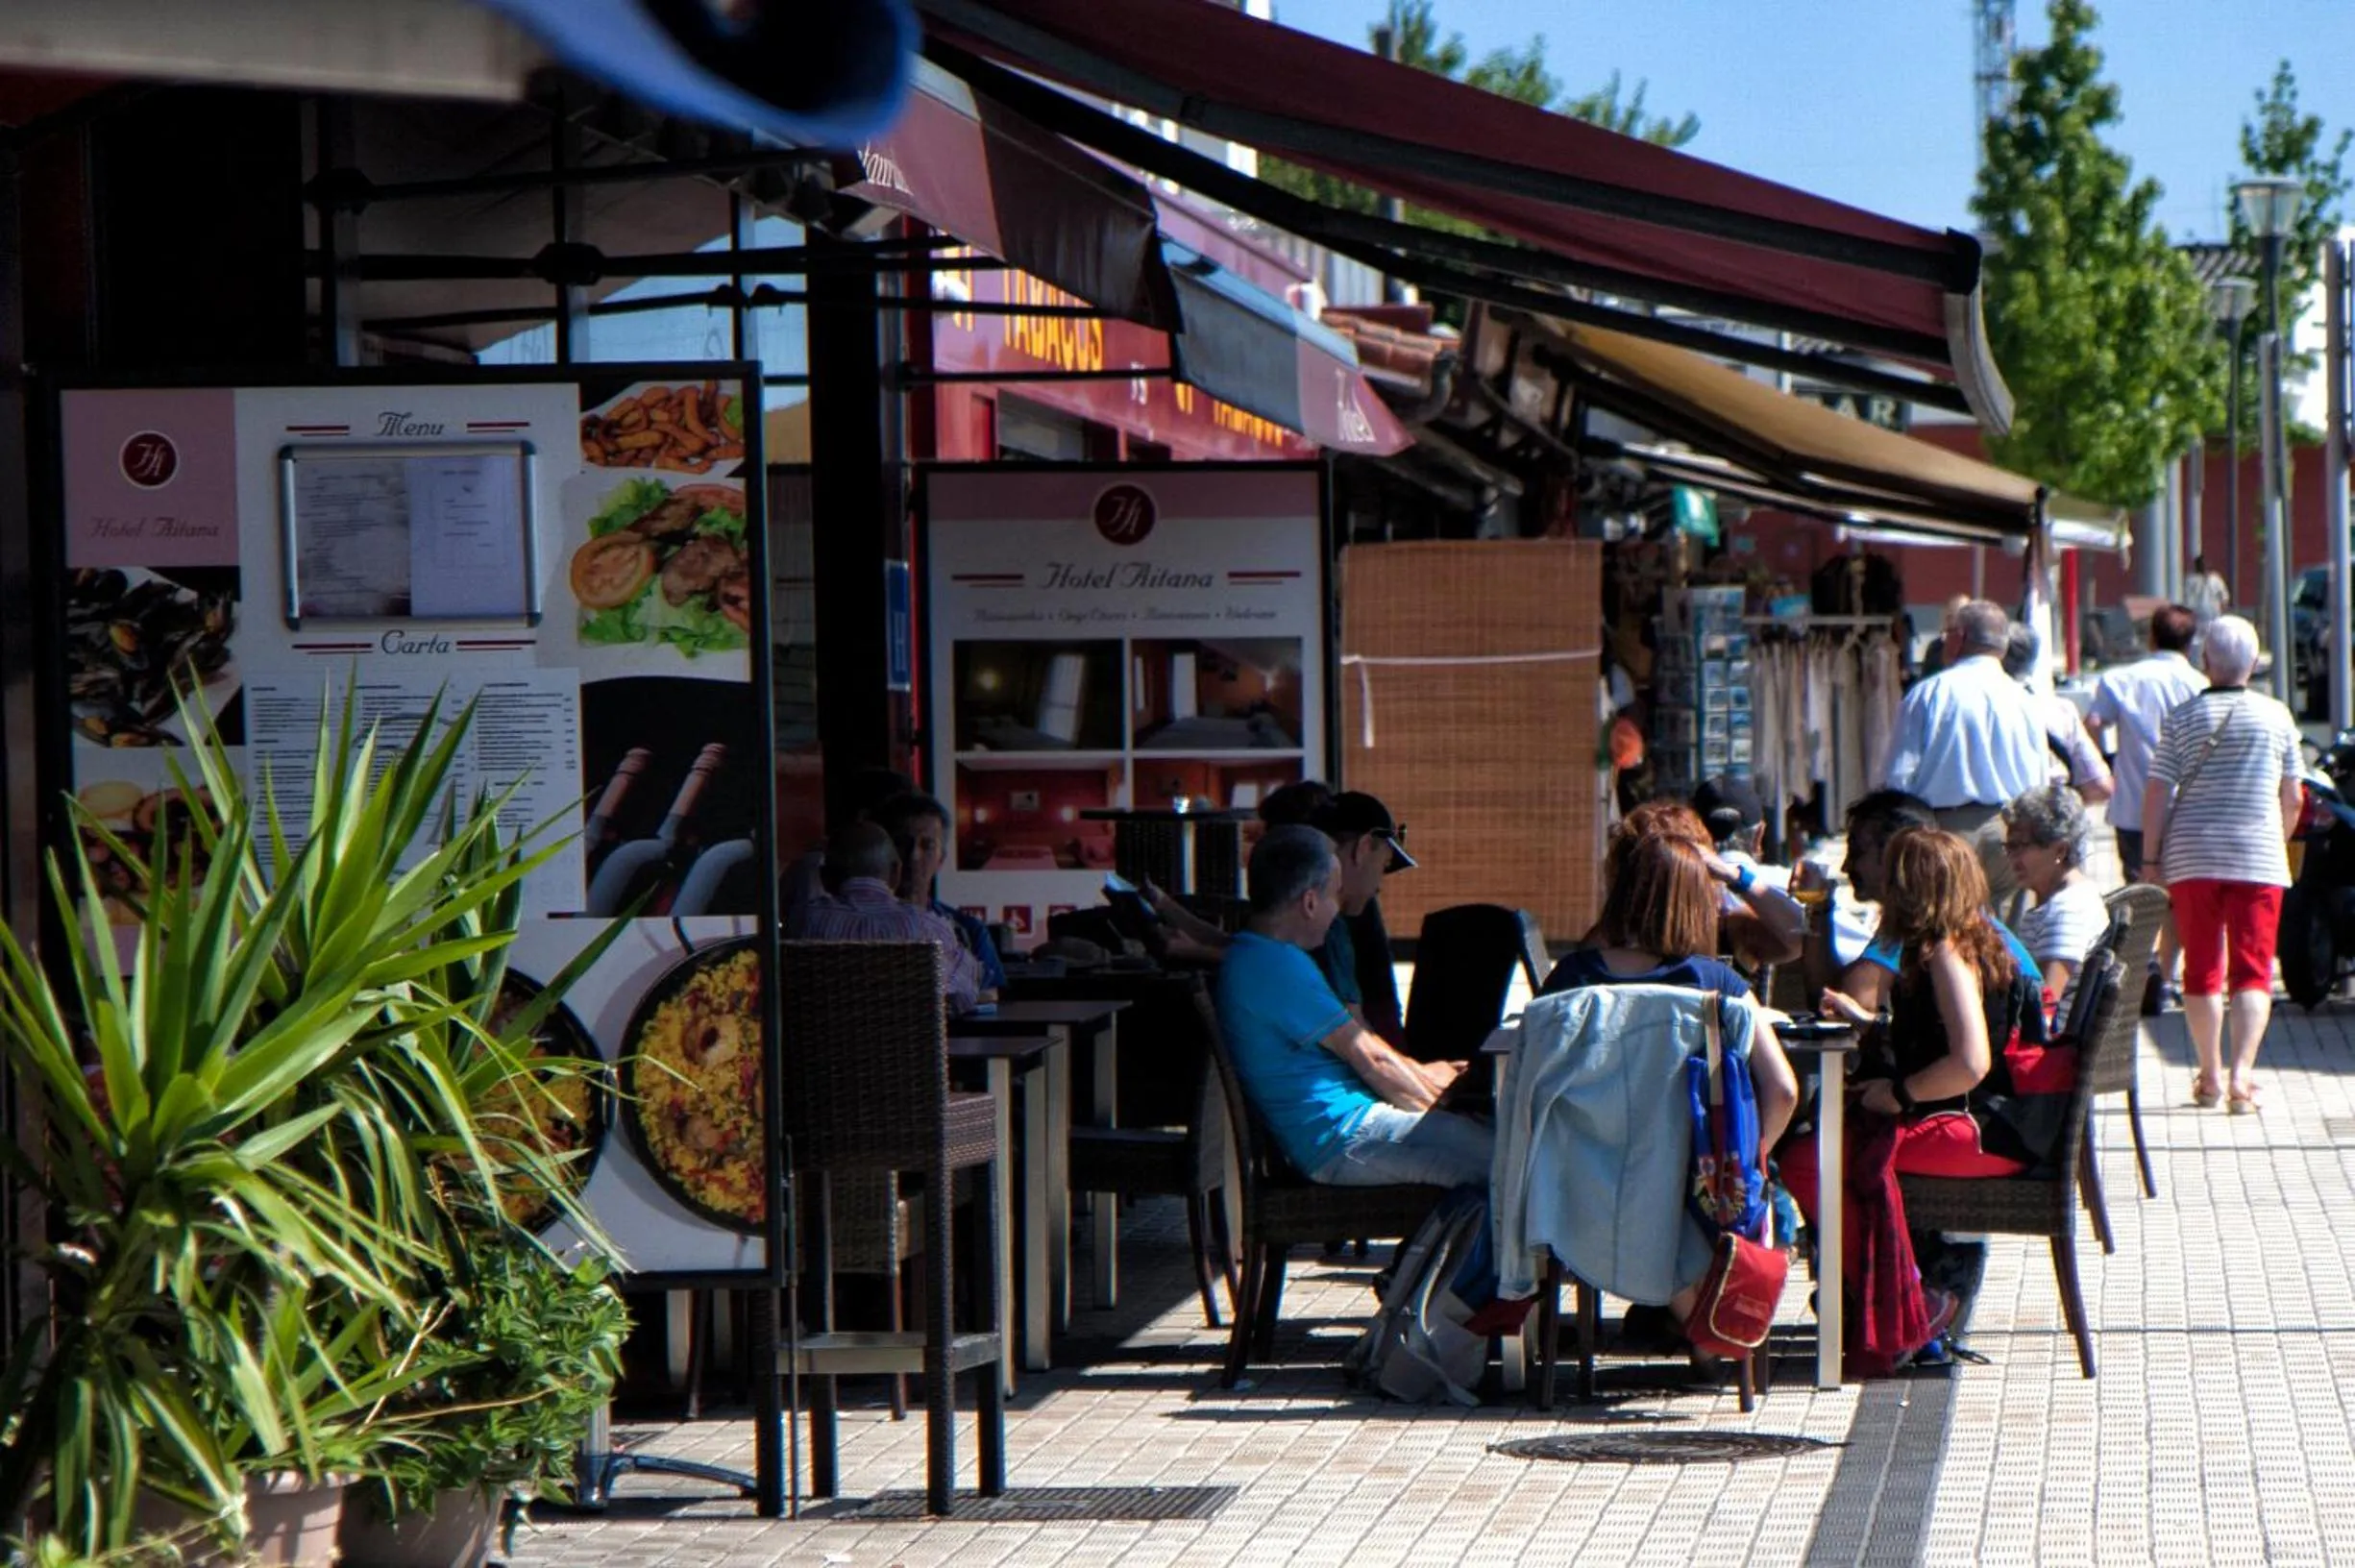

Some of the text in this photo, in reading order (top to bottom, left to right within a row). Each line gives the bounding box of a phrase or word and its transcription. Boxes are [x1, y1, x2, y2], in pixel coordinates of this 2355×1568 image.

[376, 411, 446, 437] Menu
[1038, 561, 1214, 590] Hotel Aitana
[380, 628, 452, 655] Carta
